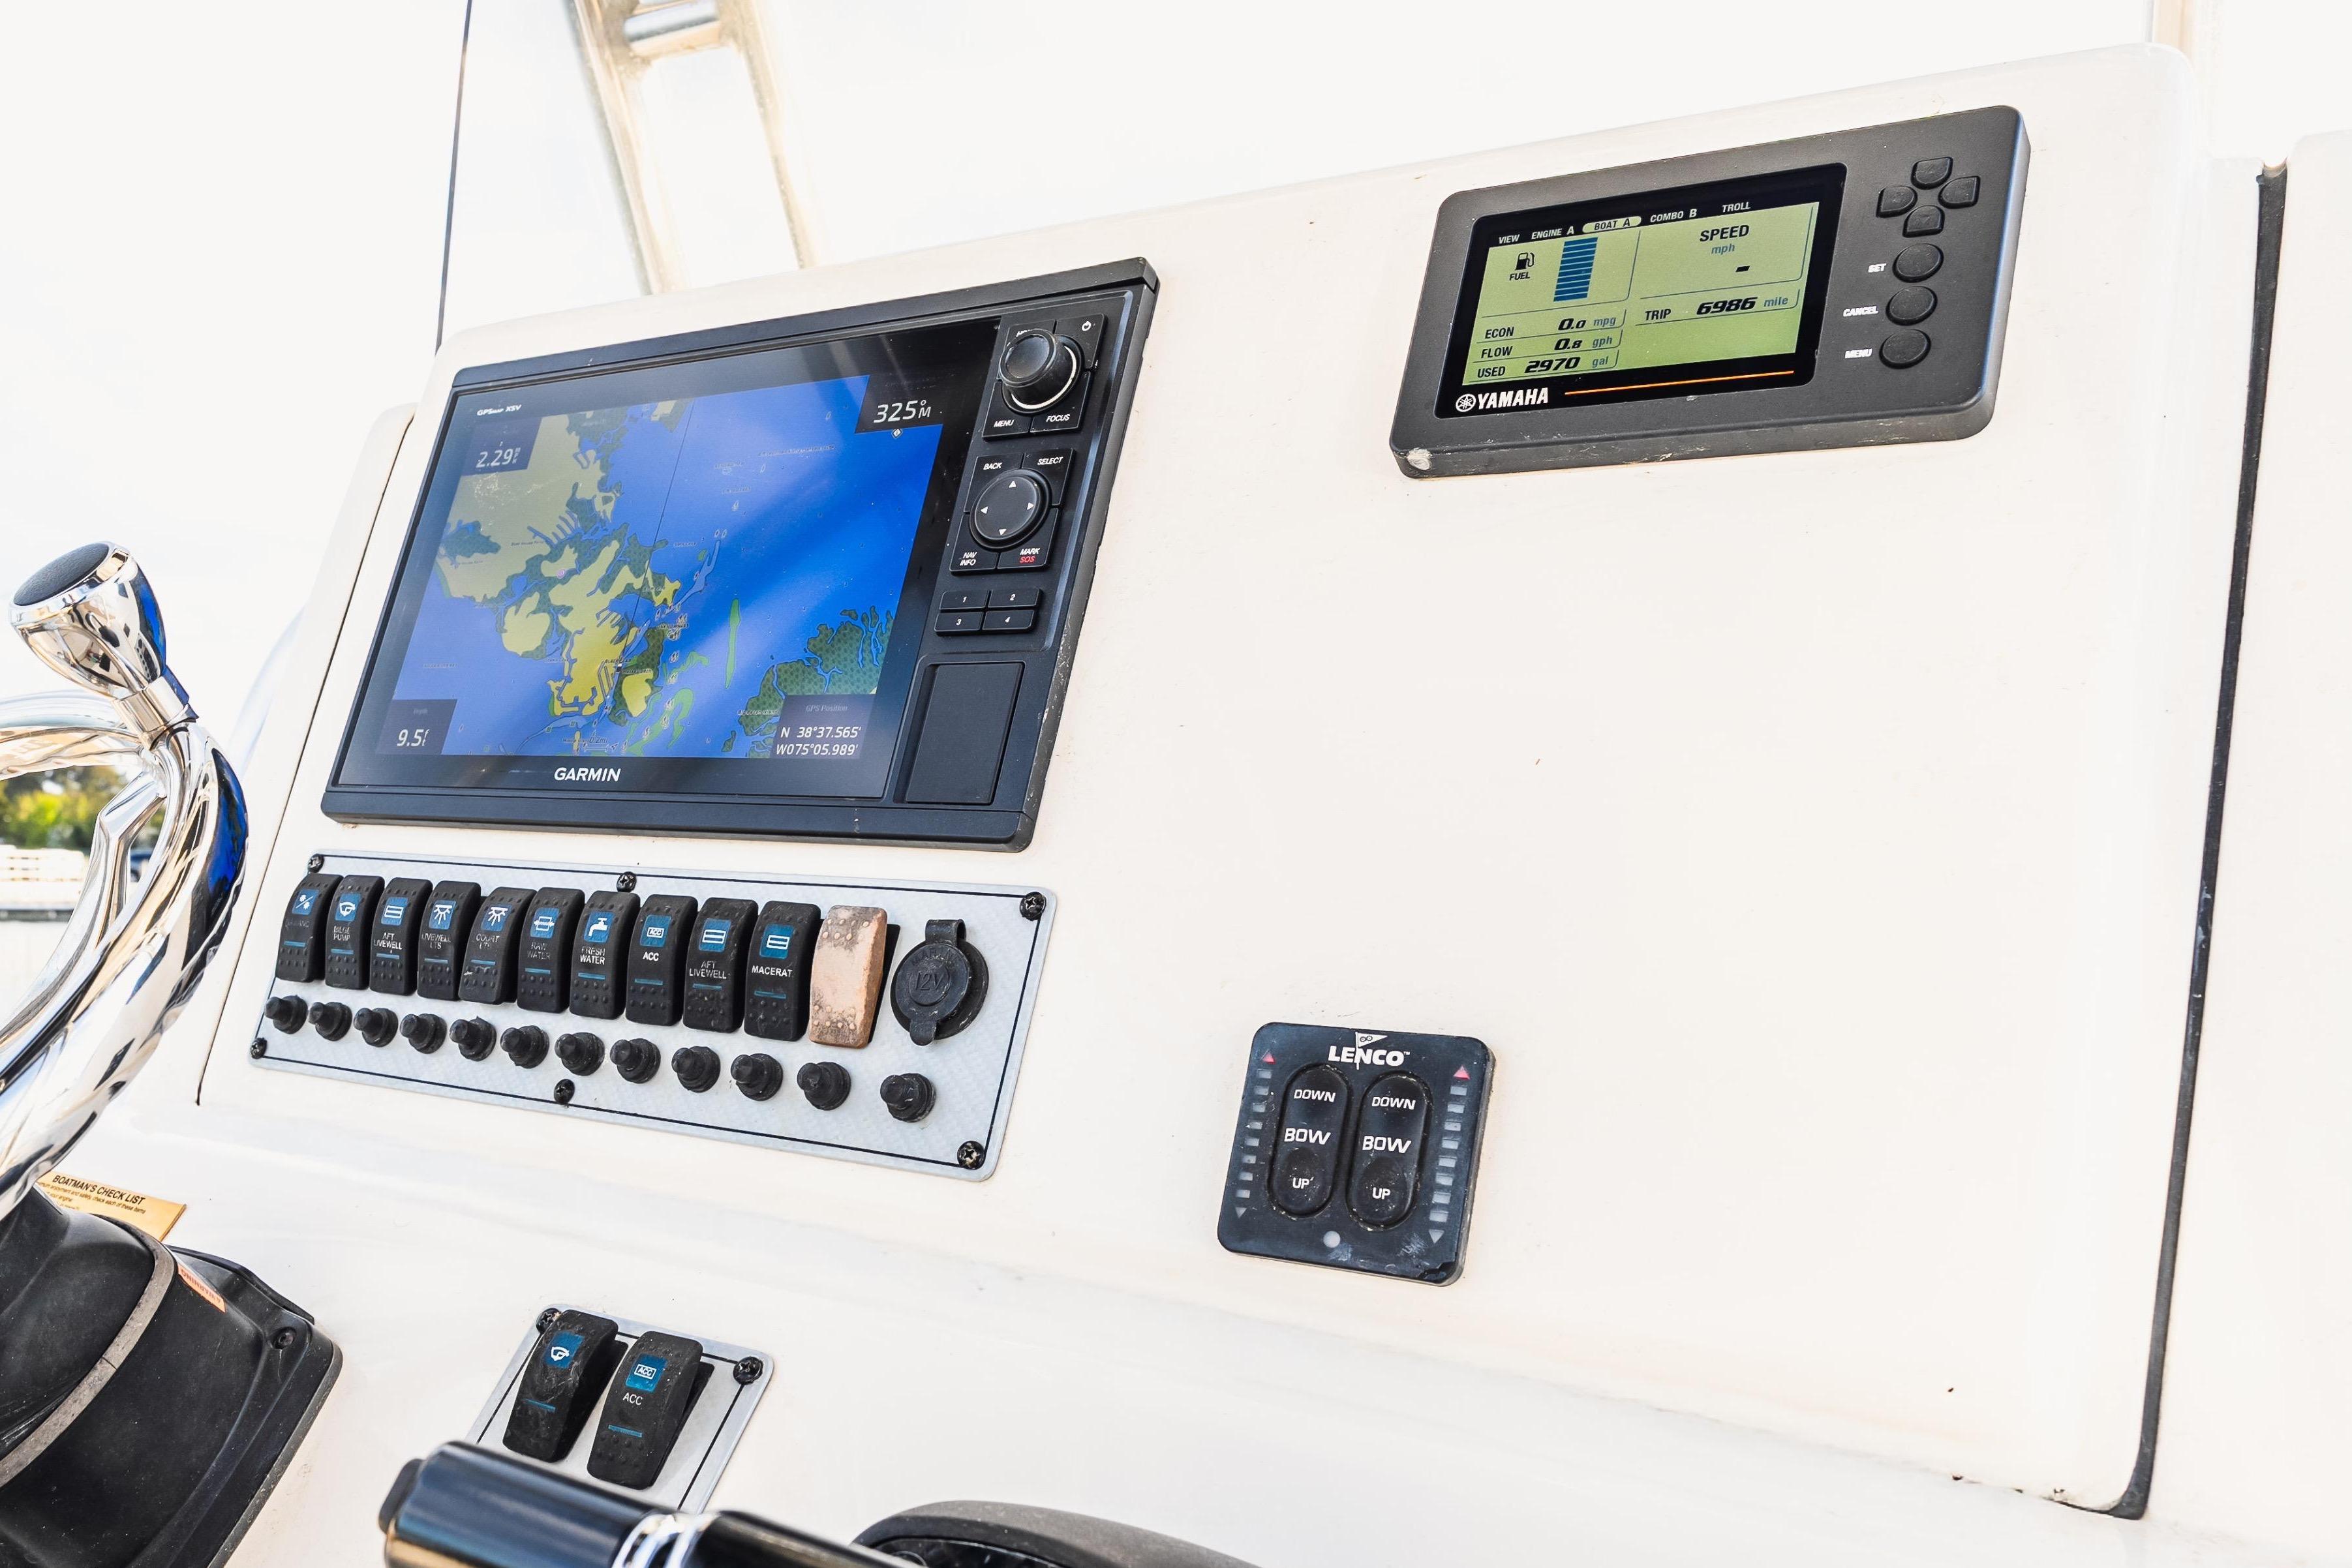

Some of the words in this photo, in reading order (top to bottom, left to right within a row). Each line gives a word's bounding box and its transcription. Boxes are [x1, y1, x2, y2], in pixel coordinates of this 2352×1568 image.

[1499, 234, 1520, 244] VIEW
[1531, 228, 1563, 240] ENGINE
[1567, 226, 1574, 235] A
[1594, 220, 1618, 231] BOAT
[1623, 218, 1631, 227] A
[1650, 211, 1685, 223] COMBO
[1689, 209, 1698, 218] B
[1722, 202, 1751, 213] TROLL
[1699, 224, 1750, 242] SPEED
[1711, 243, 1735, 255] mph
[1868, 263, 1887, 273] SET
[1509, 271, 1531, 281] FUEL
[1645, 309, 1672, 322] TRIP
[1696, 297, 1758, 316] 6986
[1764, 295, 1789, 308] mile
[1842, 305, 1879, 317] CANCEL
[1484, 326, 1514, 339] ECON
[1593, 316, 1617, 328] mpg
[1480, 346, 1513, 359] FLOW
[1554, 338, 1583, 351] 0.8
[1592, 336, 1613, 350] gph
[1844, 348, 1872, 359] MENU
[1476, 366, 1506, 378] USED
[1524, 356, 1581, 374] 2970
[1592, 355, 1610, 369] gal
[1477, 387, 1549, 409] YAMAHA
[994, 419, 1015, 429] MENU
[1046, 414, 1070, 423] FOCUS
[476, 448, 514, 468] 2.29
[1037, 457, 1064, 466] SELECT
[983, 461, 1002, 470] BACK
[1020, 547, 1041, 556] MARK
[959, 558, 976, 567] INFO
[1019, 555, 1036, 564] SOS
[1009, 594, 1016, 602] 2
[780, 727, 790, 738] N
[554, 767, 621, 781] GARMIN
[333, 933, 351, 941] PUMP
[382, 932, 395, 941] AFT
[373, 939, 403, 950] LIVEWELL
[581, 945, 606, 956] FRESH
[579, 954, 606, 965] WATER
[642, 951, 660, 961] ACC
[701, 960, 716, 969] AFT
[689, 968, 727, 980] LIVEWELL
[915, 971, 945, 991] 12V
[1293, 1088, 1336, 1103] DOWN
[1371, 1096, 1416, 1110] DOWN
[1283, 1127, 1332, 1145] BOW
[1362, 1135, 1412, 1154] BOW
[1292, 1177, 1310, 1190] UP
[52, 1175, 98, 1193] BOATMAN'S
[97, 1186, 127, 1201] CHECK
[125, 1193, 146, 1205] LIST
[1372, 1186, 1391, 1200] UP
[637, 1366, 654, 1377] ACC
[622, 1392, 643, 1406] ACC
